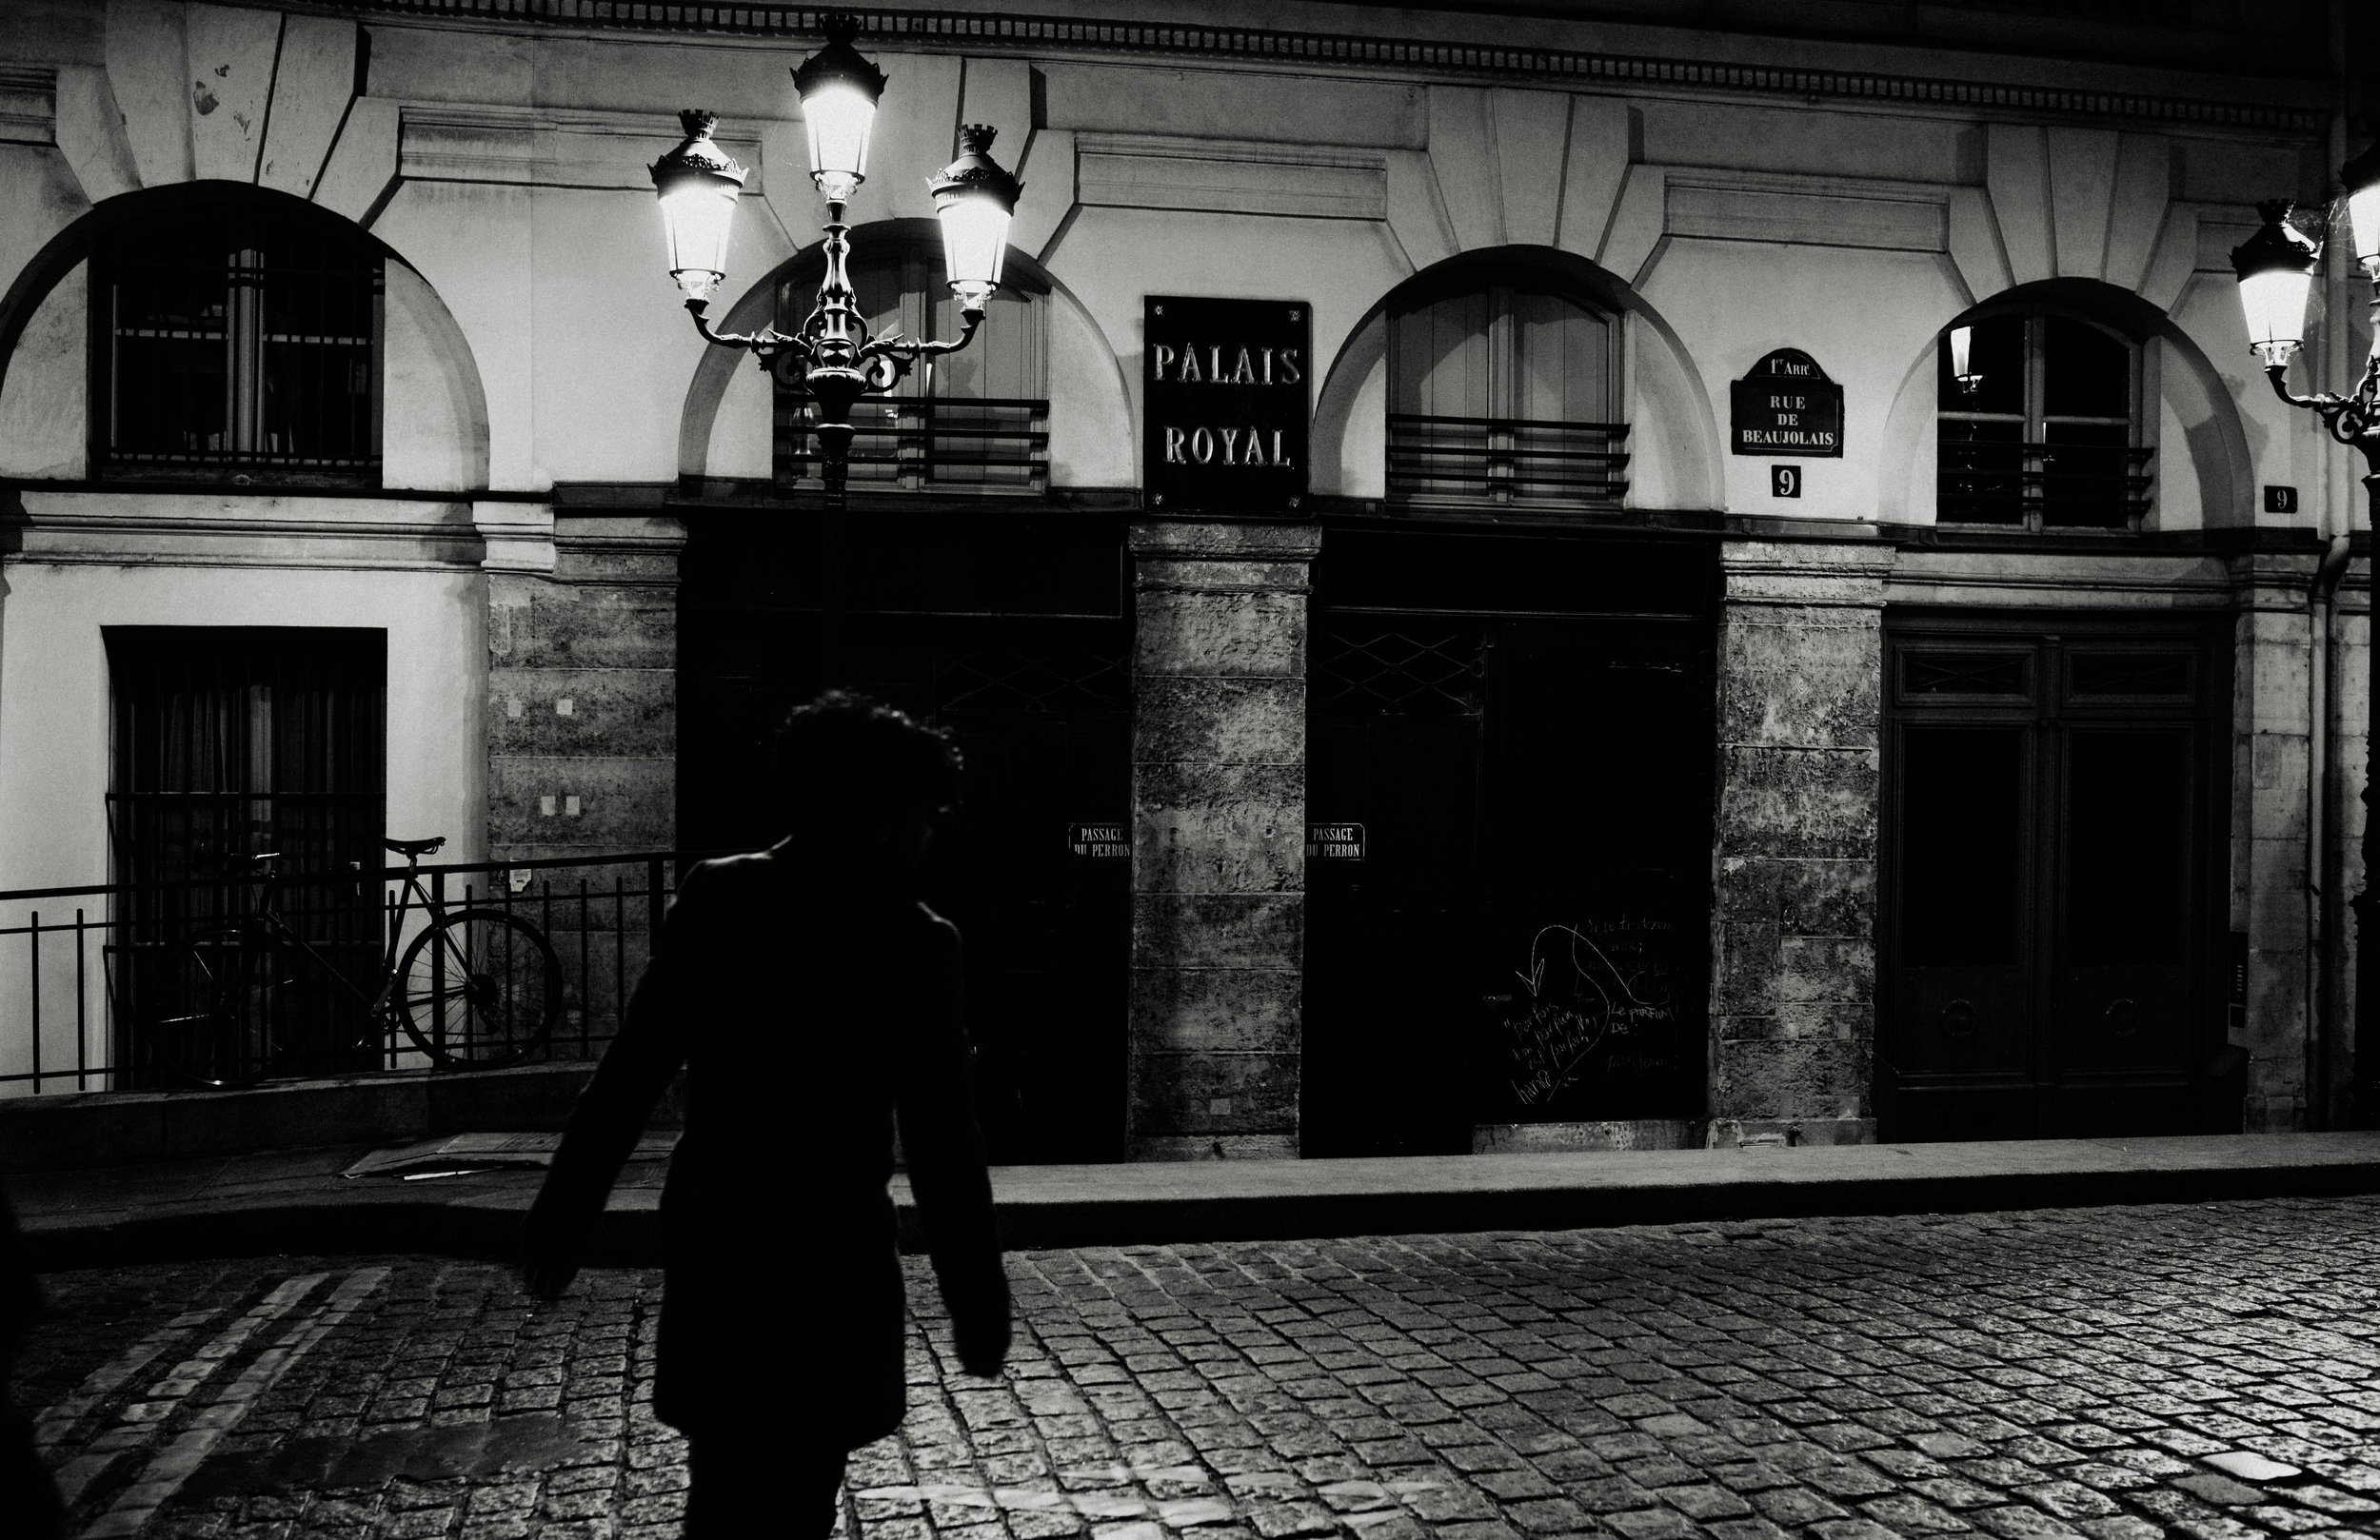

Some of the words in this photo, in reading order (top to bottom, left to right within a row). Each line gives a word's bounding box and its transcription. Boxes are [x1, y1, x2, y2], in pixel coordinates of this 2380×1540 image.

[1153, 342, 1300, 385] PALAIS
[1770, 395, 1805, 409] RUE
[1776, 413, 1798, 426] DE
[1742, 429, 1835, 445] BEAUJOLAIS
[1162, 424, 1291, 467] ROYAL
[1778, 469, 1795, 496] 9
[2276, 489, 2288, 509] 9
[1081, 827, 1123, 841] PASSAGE
[1313, 827, 1354, 841] PASSAGE
[1092, 843, 1131, 858] PERRON
[1305, 843, 1319, 857] DU
[1323, 843, 1360, 858] PERRON
